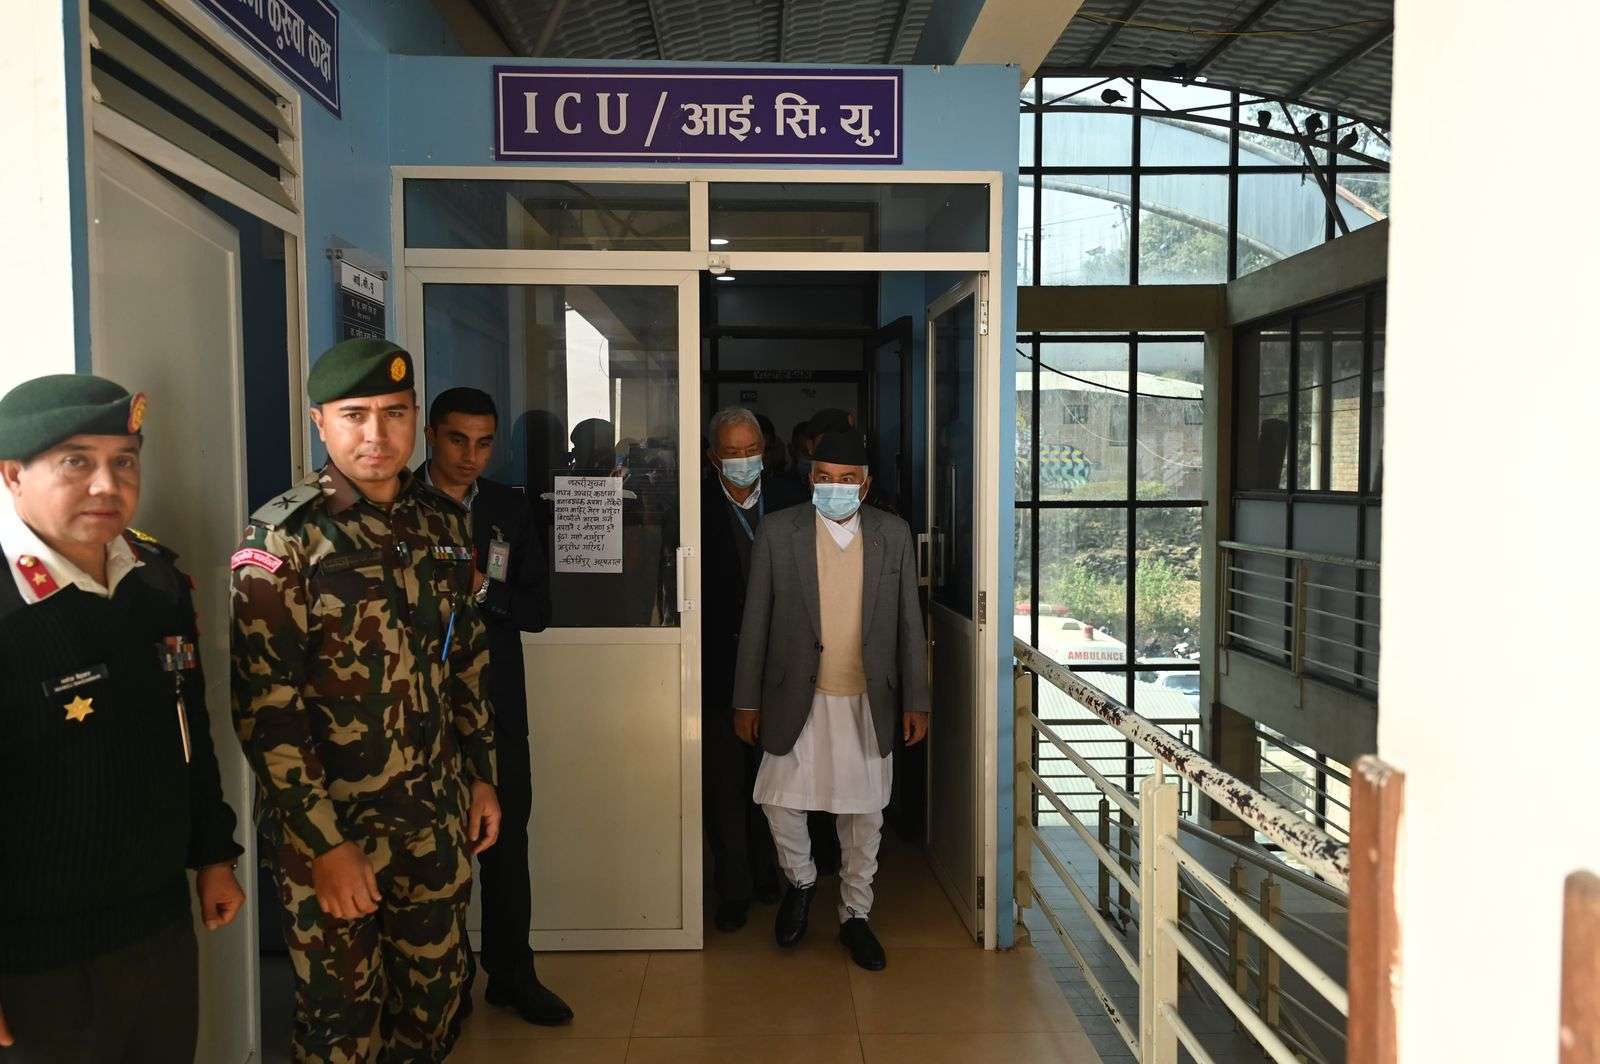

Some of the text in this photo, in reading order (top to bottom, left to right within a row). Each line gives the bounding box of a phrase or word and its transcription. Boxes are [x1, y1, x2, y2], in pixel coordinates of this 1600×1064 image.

[307, 25, 332, 83] कक्ष
[523, 91, 629, 135] ICU
[680, 94, 762, 142] आई.
[775, 92, 827, 140] सि.
[840, 104, 881, 147] यु.
[1067, 650, 1124, 661] AMBULANCE
